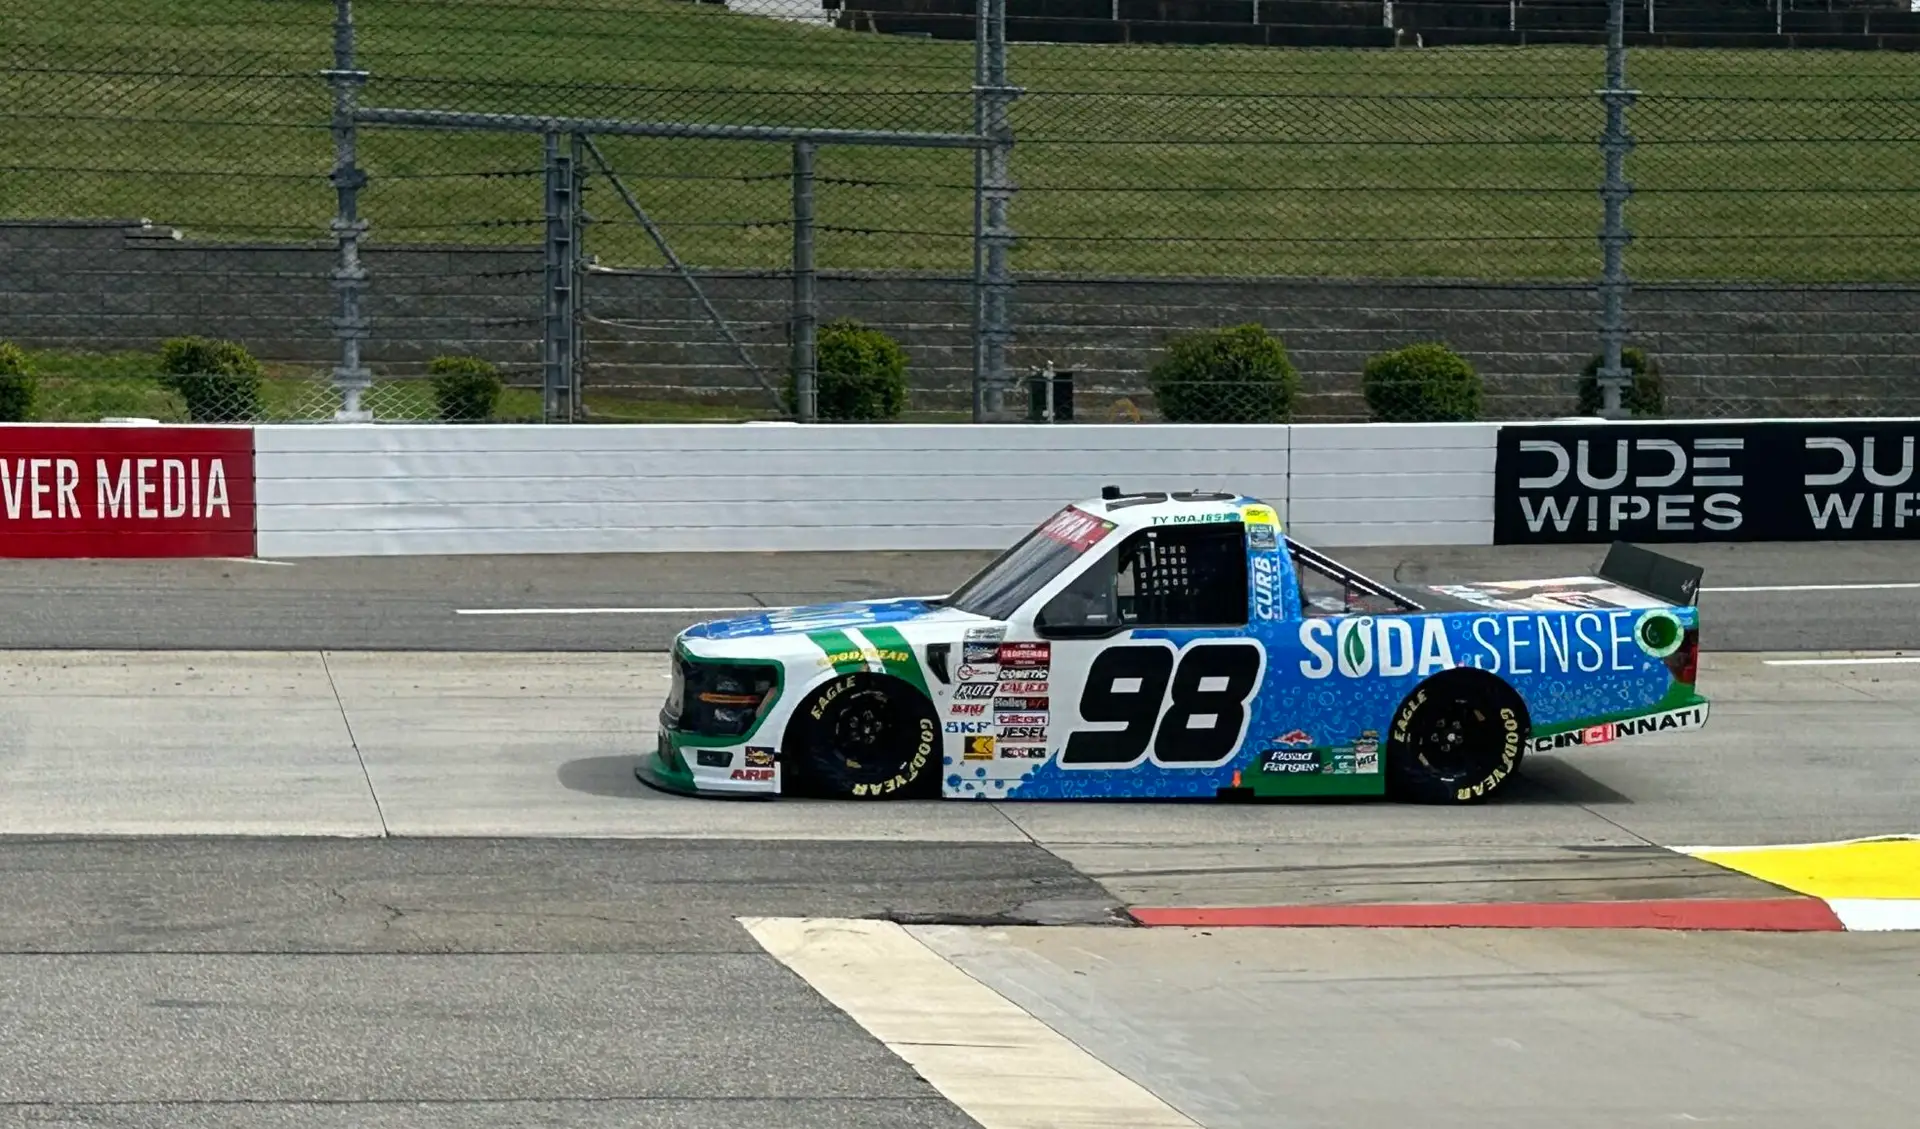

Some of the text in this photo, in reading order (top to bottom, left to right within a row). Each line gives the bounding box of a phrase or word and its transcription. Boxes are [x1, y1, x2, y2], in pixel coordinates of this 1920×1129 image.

[1519, 438, 1744, 489] DUDE
[1805, 436, 1915, 486] DU
[0, 458, 231, 519] VER MEDIA
[1519, 493, 1744, 533] WIPES
[1151, 516, 1168, 525] TY
[1254, 556, 1273, 620] CURB
[1299, 611, 1635, 679] SODA SENSE
[810, 675, 857, 721] EAGLE
[1060, 642, 1263, 764] 98
[1393, 688, 1429, 743] EAGLE
[945, 721, 991, 734] SKF
[997, 726, 1047, 738] JESEL
[730, 769, 775, 781] ARP
[852, 717, 934, 797] GOODYEAR
[1262, 762, 1320, 773] Ranger
[1271, 751, 1313, 761] Road
[1456, 708, 1519, 801] GOODYEAR
